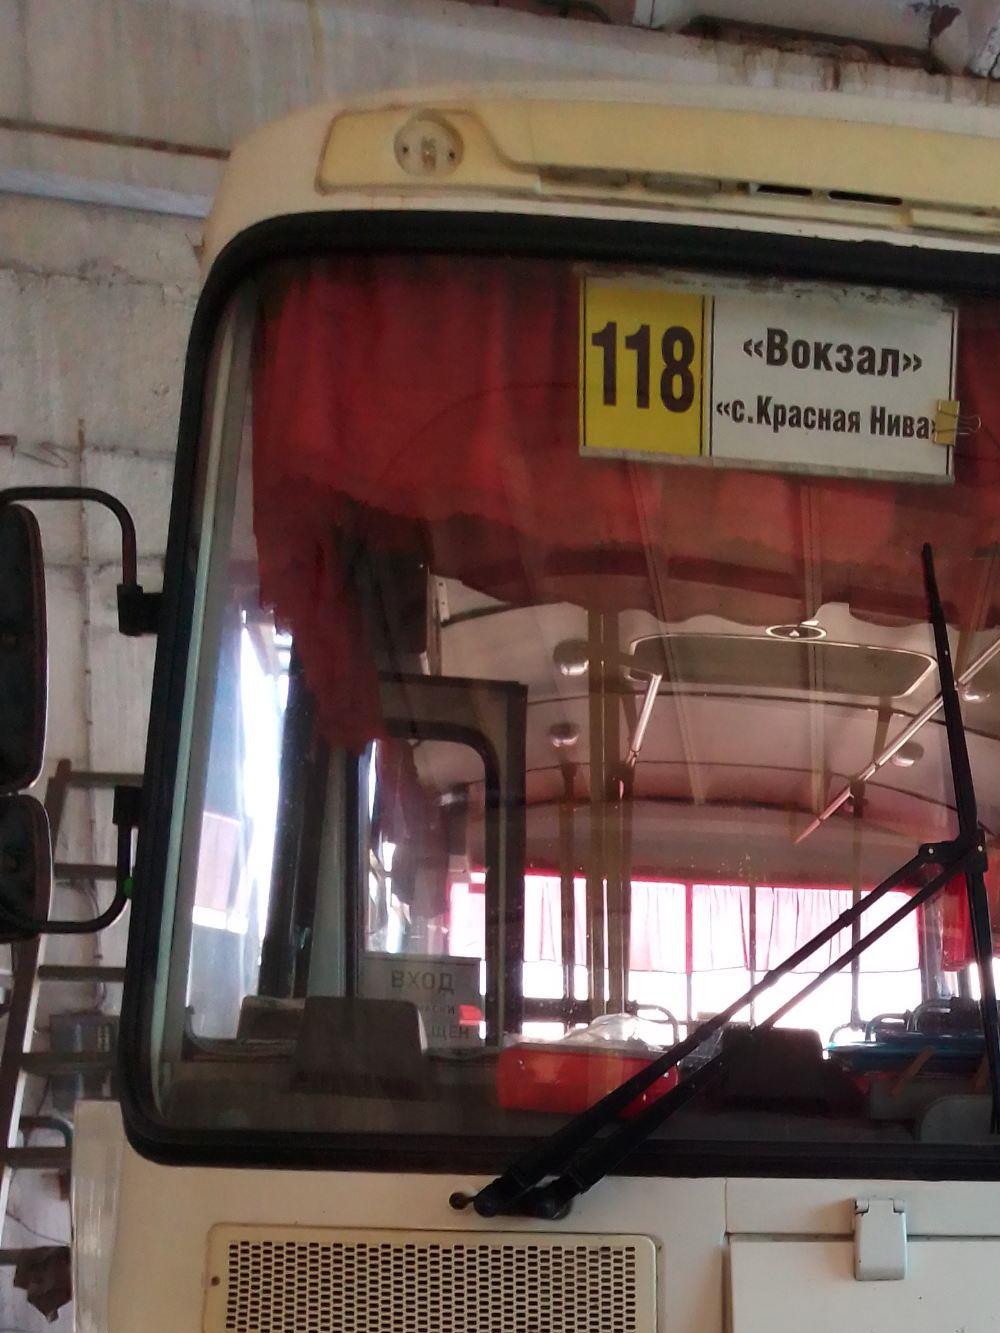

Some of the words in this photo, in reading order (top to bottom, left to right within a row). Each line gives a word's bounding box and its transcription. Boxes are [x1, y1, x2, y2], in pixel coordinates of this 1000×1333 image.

[591, 321, 695, 413] 118
[743, 327, 923, 377] «Вокзал»
[870, 405, 937, 440] Нива
[390, 970, 454, 993] ВХОД
